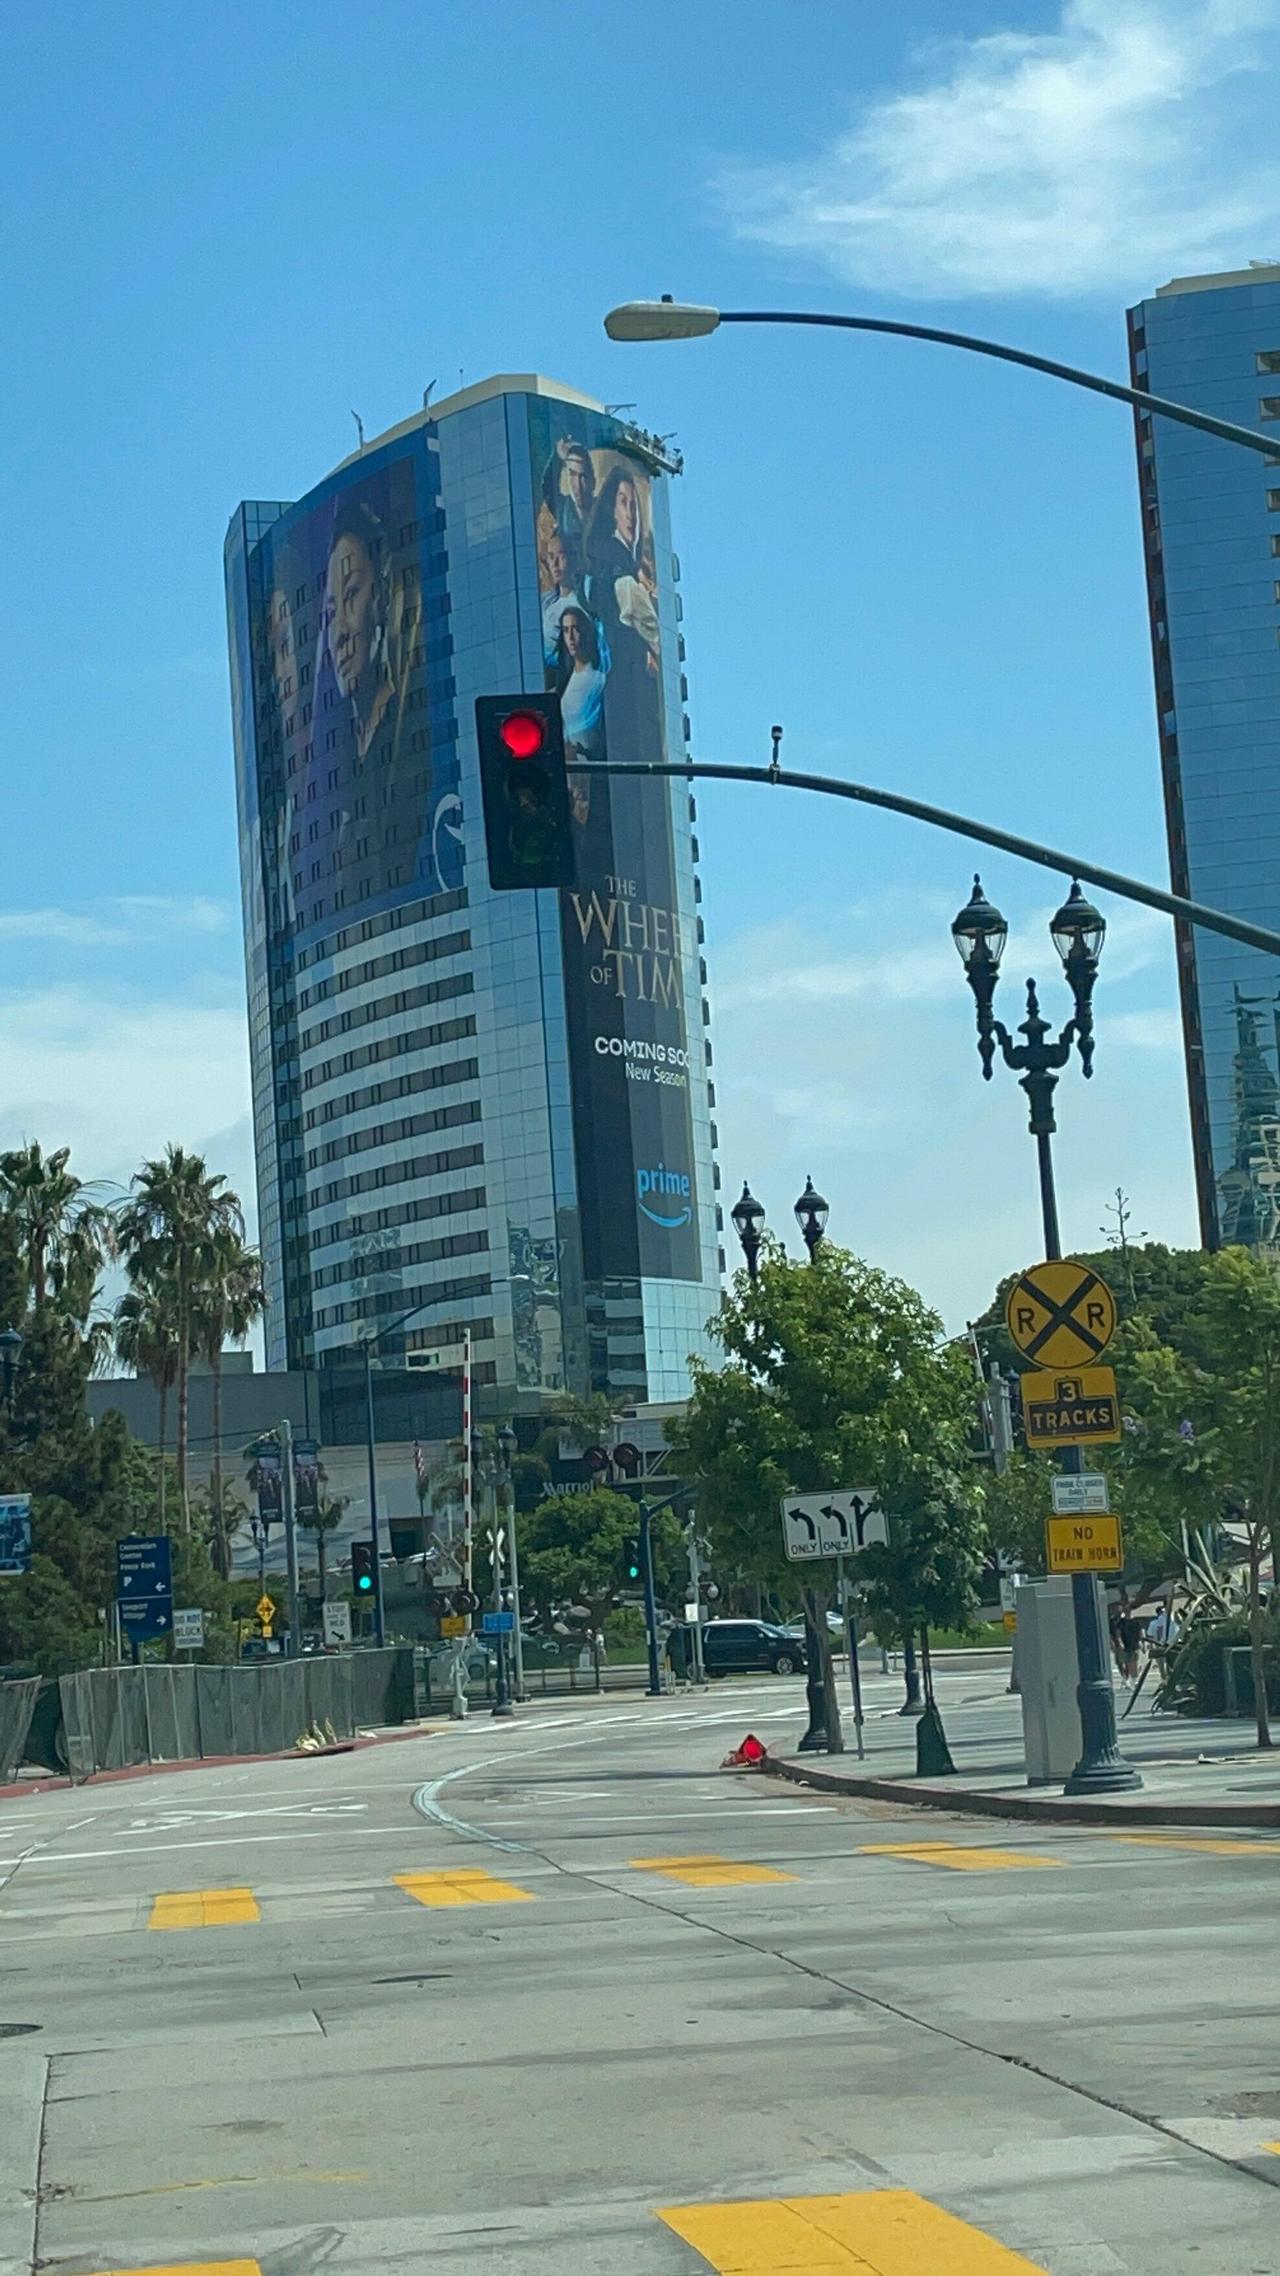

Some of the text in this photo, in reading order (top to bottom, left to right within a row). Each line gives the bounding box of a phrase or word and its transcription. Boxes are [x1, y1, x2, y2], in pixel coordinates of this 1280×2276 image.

[605, 874, 637, 897] THE
[590, 966, 612, 985] OF
[595, 1036, 666, 1061] COMING
[625, 1062, 687, 1087] New Season
[637, 1162, 690, 1199] prime
[1017, 1302, 1105, 1334] R R
[1062, 1382, 1077, 1402] 3
[1032, 1407, 1110, 1429] TRACKS
[1073, 1527, 1093, 1540] NO
[791, 1540, 849, 1555] ONLY ONLY
[1053, 1546, 1117, 1561] TRAIN HORN
